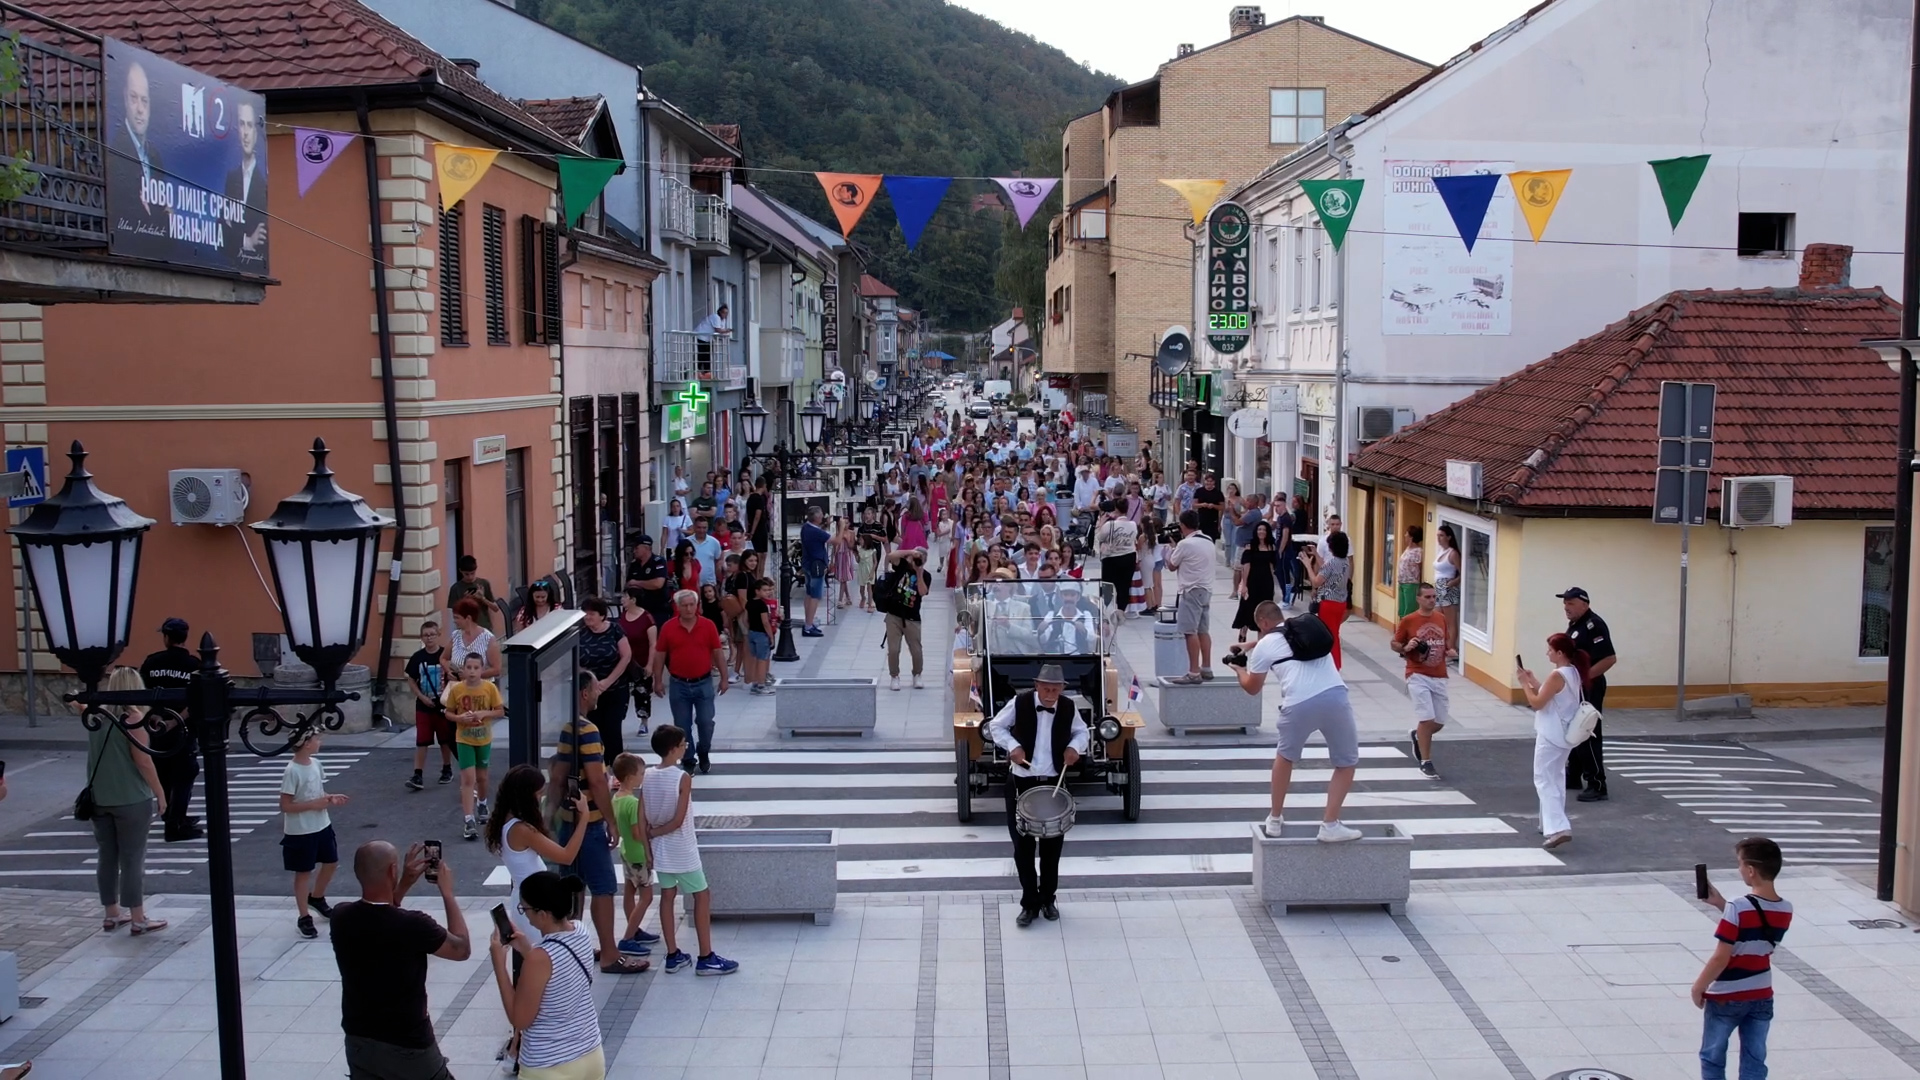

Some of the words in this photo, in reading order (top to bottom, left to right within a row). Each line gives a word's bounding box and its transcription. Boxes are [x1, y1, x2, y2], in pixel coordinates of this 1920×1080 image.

[215, 97, 225, 131] 2
[1393, 164, 1451, 177] DOMAĆA
[1393, 181, 1440, 193] KUHIN
[141, 176, 173, 208] НОВО
[177, 185, 207, 218] ЛИЦЕ
[210, 193, 246, 224] СРБИЈЕ
[169, 213, 224, 250] ИВАЊИЦА
[1211, 247, 1226, 310] РАДИО
[1232, 247, 1247, 310] ЈАВОР
